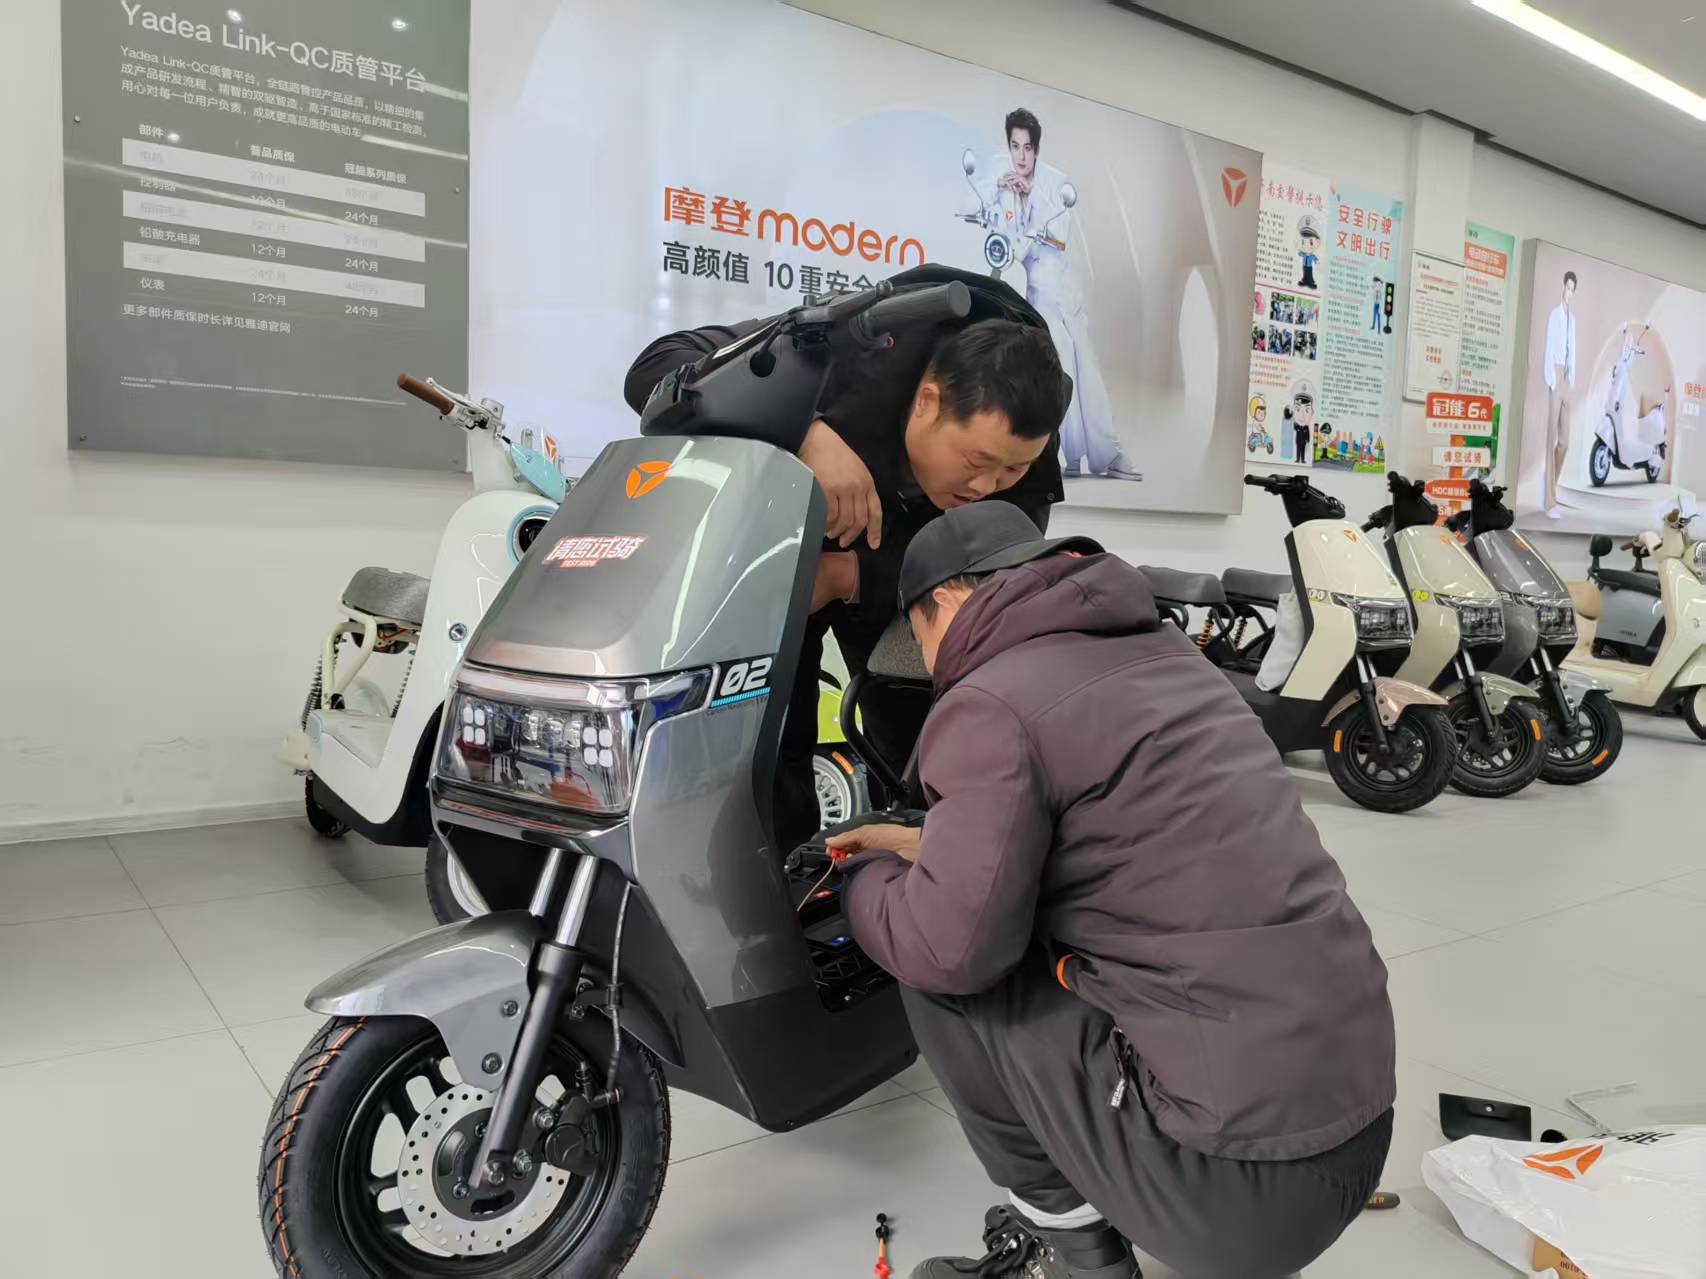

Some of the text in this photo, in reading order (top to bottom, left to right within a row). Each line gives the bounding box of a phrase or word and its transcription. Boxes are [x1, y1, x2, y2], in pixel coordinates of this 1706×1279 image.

[120, 1, 427, 93] Yadea Link-QC质管平台
[120, 45, 159, 63] Yadea
[139, 124, 164, 137] 部件
[344, 211, 378, 225] 24个月
[1338, 204, 1393, 235] 安全行驶
[252, 244, 286, 258] 12个月
[1336, 230, 1391, 261] 文明出行
[345, 258, 378, 272] 24个月
[662, 240, 750, 285] 高颜值
[140, 277, 165, 290] 仪表
[252, 292, 286, 305] 12个月
[345, 305, 378, 318] 24个月
[720, 657, 773, 696] 02
